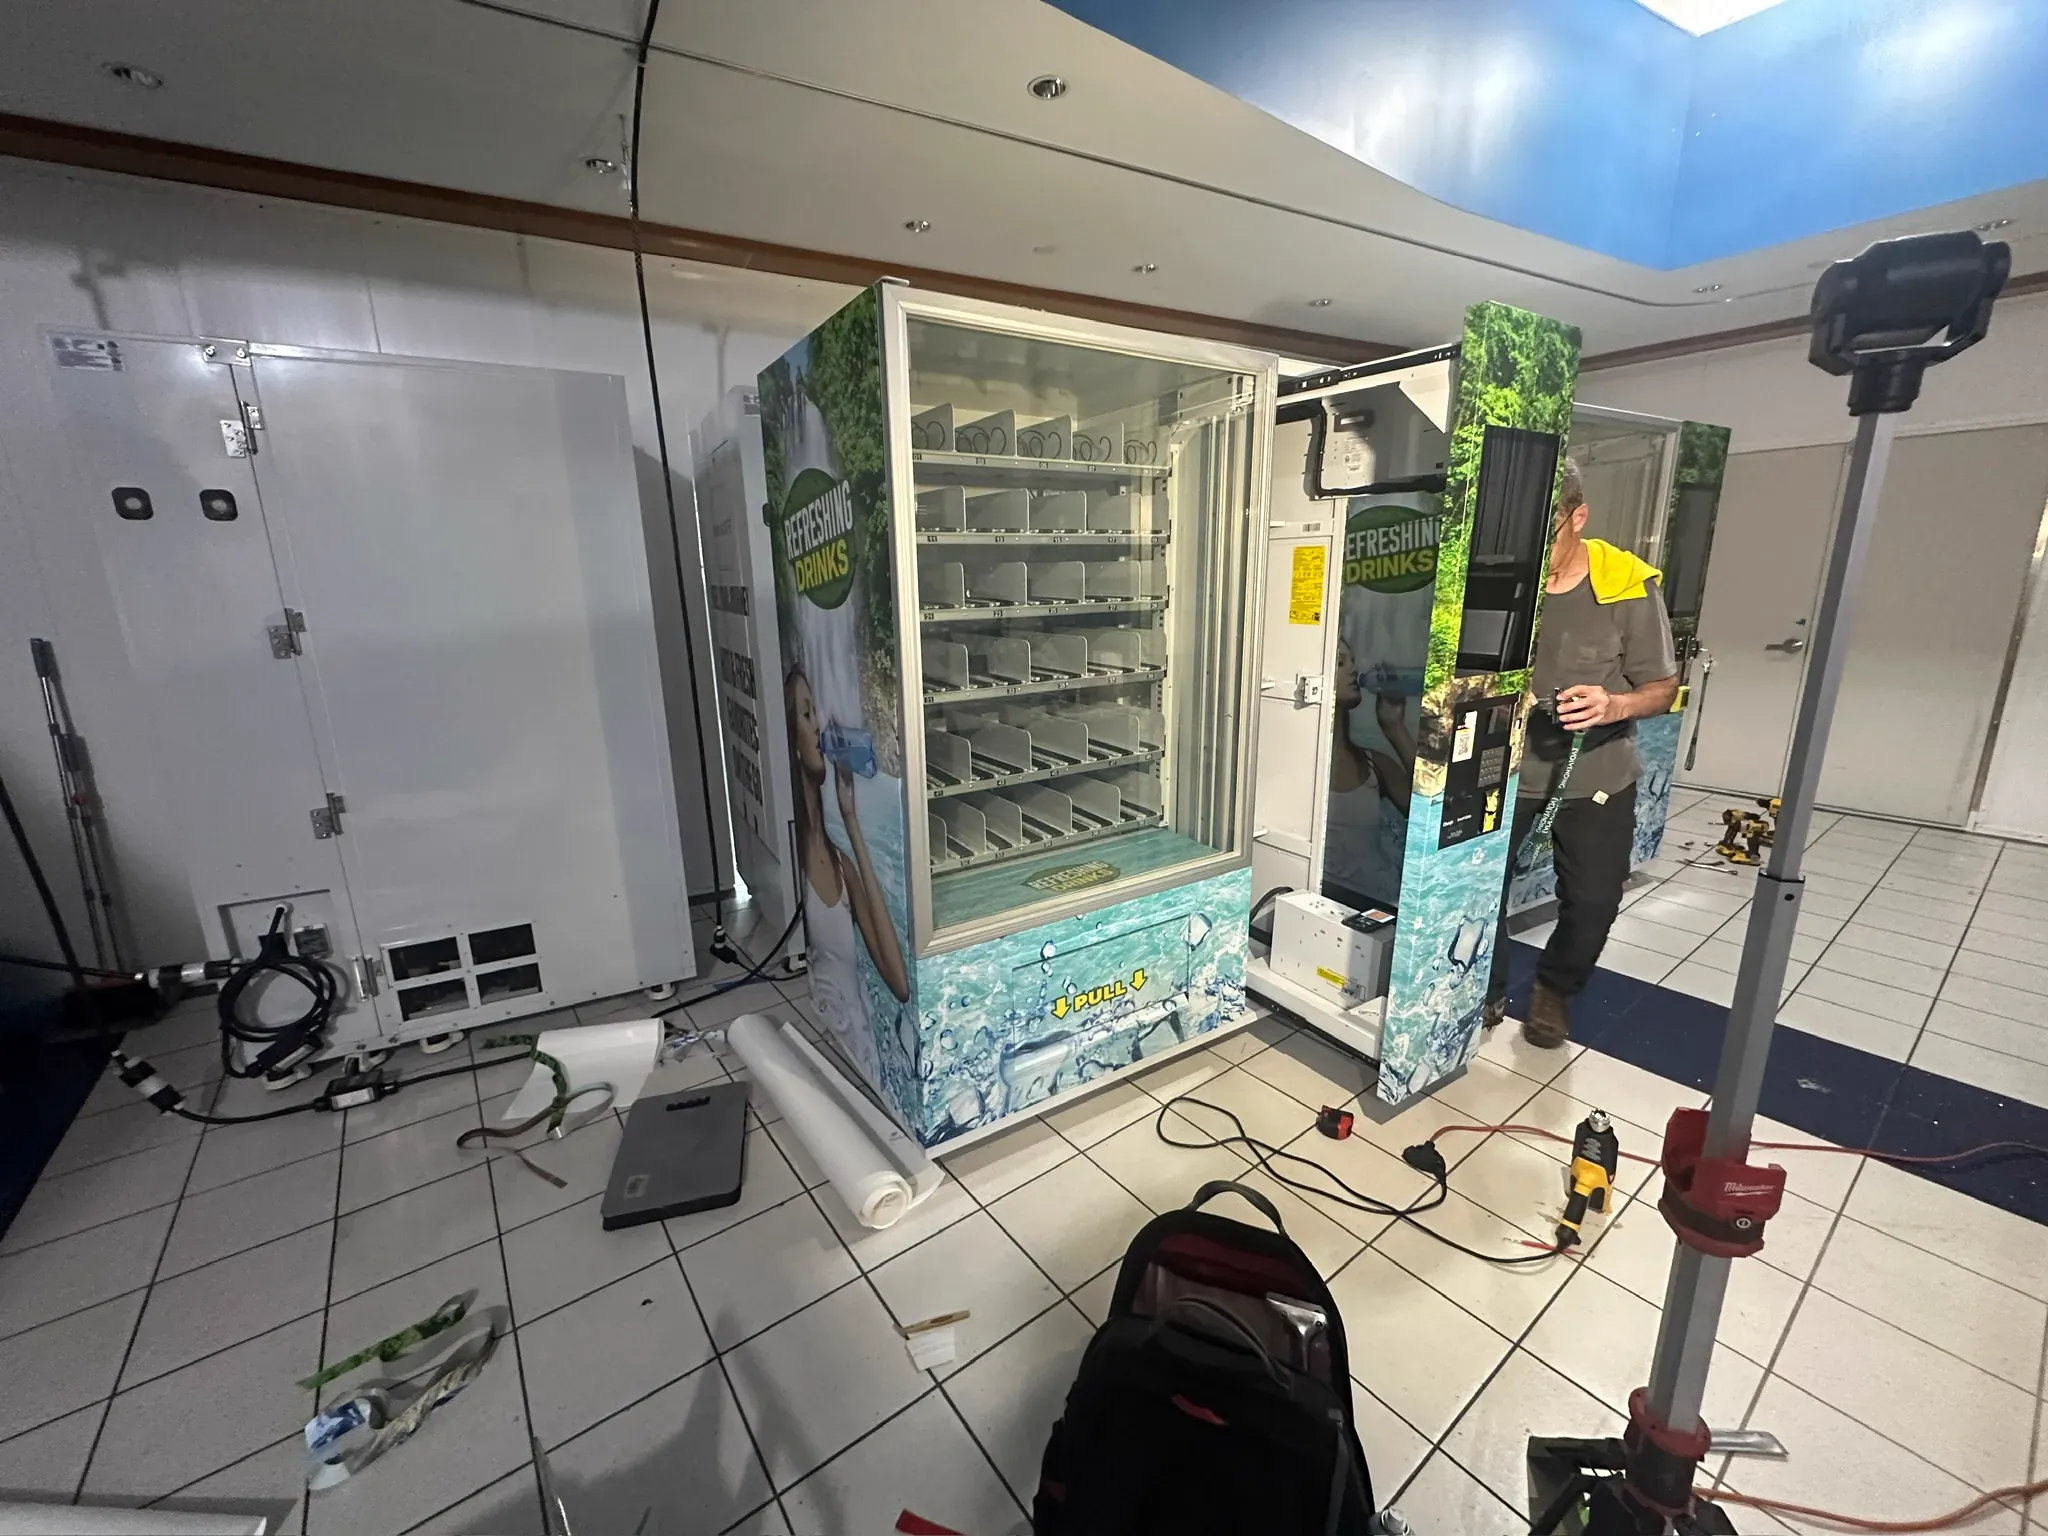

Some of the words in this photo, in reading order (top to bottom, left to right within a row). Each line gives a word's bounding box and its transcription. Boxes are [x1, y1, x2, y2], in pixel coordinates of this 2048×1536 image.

[784, 480, 853, 560] REFRESHING
[1345, 514, 1443, 561] EFRESHIN
[795, 538, 849, 592] DRINKS
[1346, 550, 1435, 584] DRINKS
[1027, 860, 1109, 890] REFRESHING
[1051, 868, 1114, 893] DRINKS
[1074, 980, 1127, 1012] PULL
